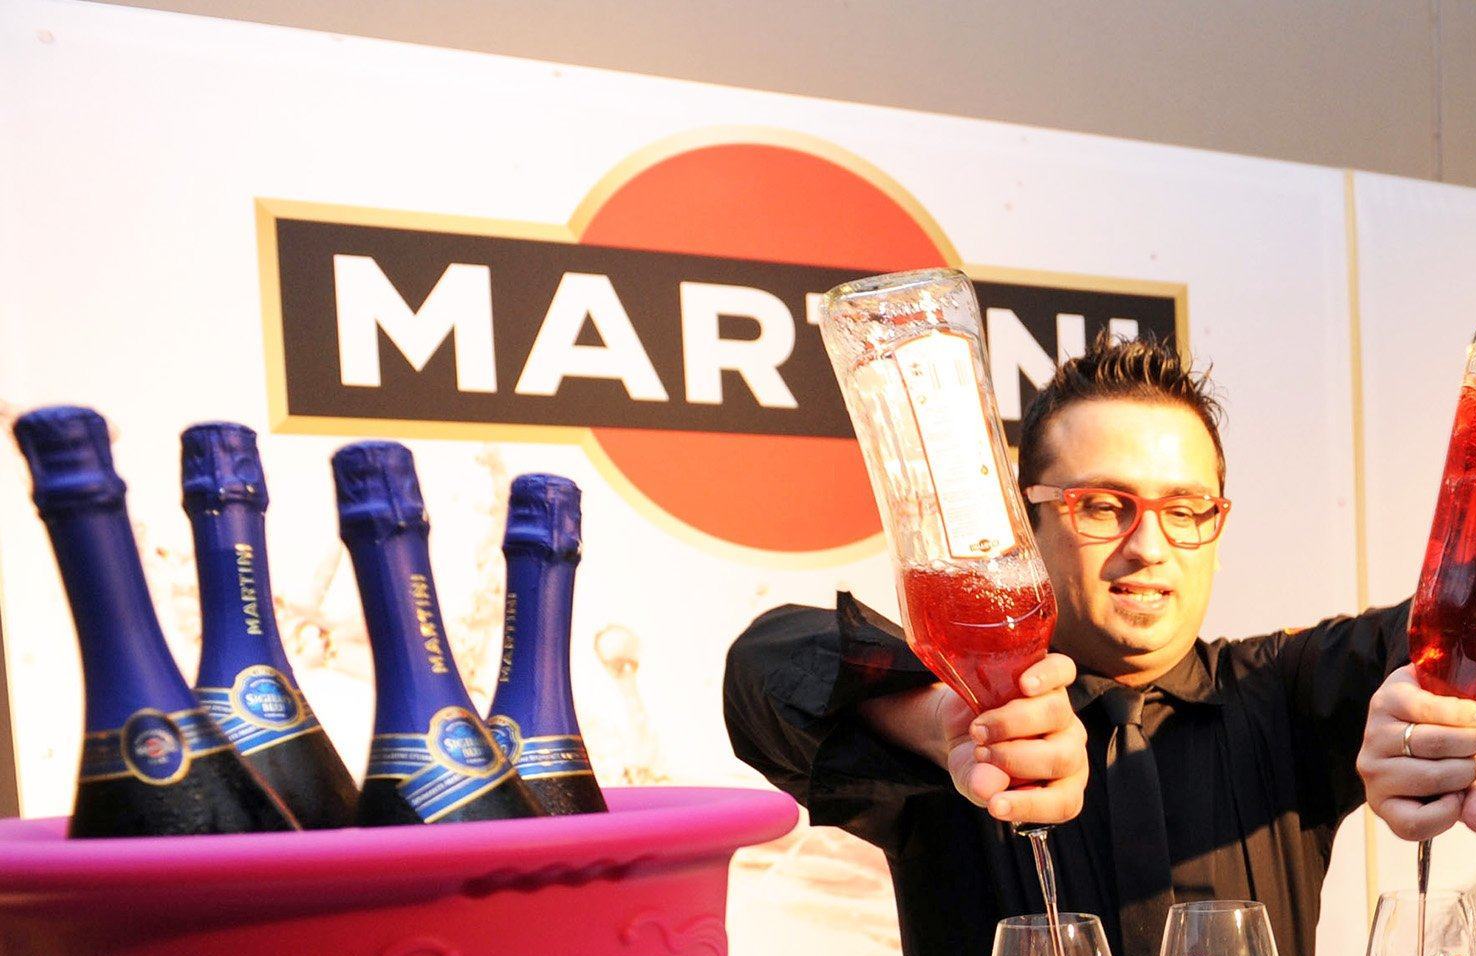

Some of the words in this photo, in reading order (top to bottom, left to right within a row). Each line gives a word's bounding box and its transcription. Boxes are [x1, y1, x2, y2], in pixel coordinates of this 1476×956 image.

[331, 253, 1140, 421] MARN
[235, 543, 263, 635] MARTINI
[410, 574, 449, 674] MARTINI
